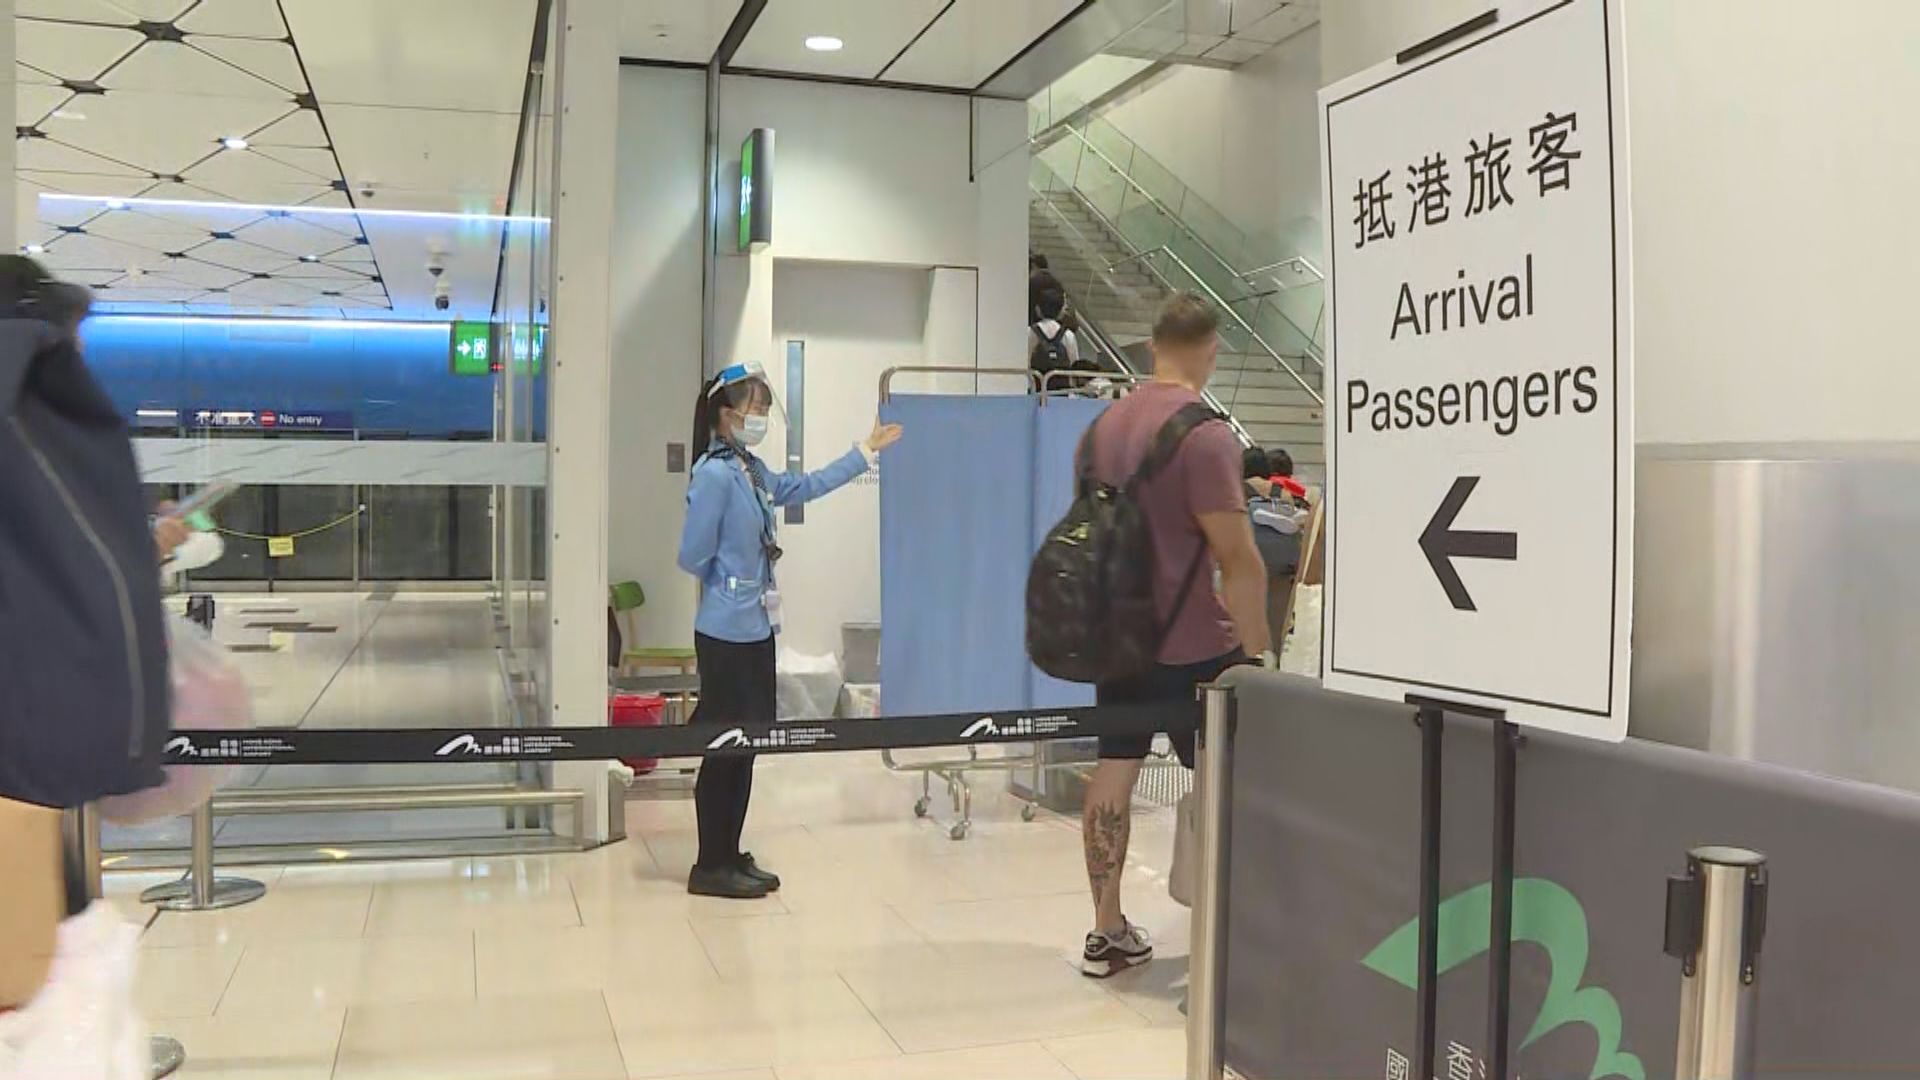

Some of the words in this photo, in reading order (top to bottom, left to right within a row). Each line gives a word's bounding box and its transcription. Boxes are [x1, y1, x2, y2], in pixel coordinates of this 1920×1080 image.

[1352, 111, 1583, 249] 抵港旅客
[1389, 253, 1535, 340] Arrival
[279, 414, 294, 425] No
[296, 415, 322, 427] entry
[1346, 363, 1599, 436] Passengers
